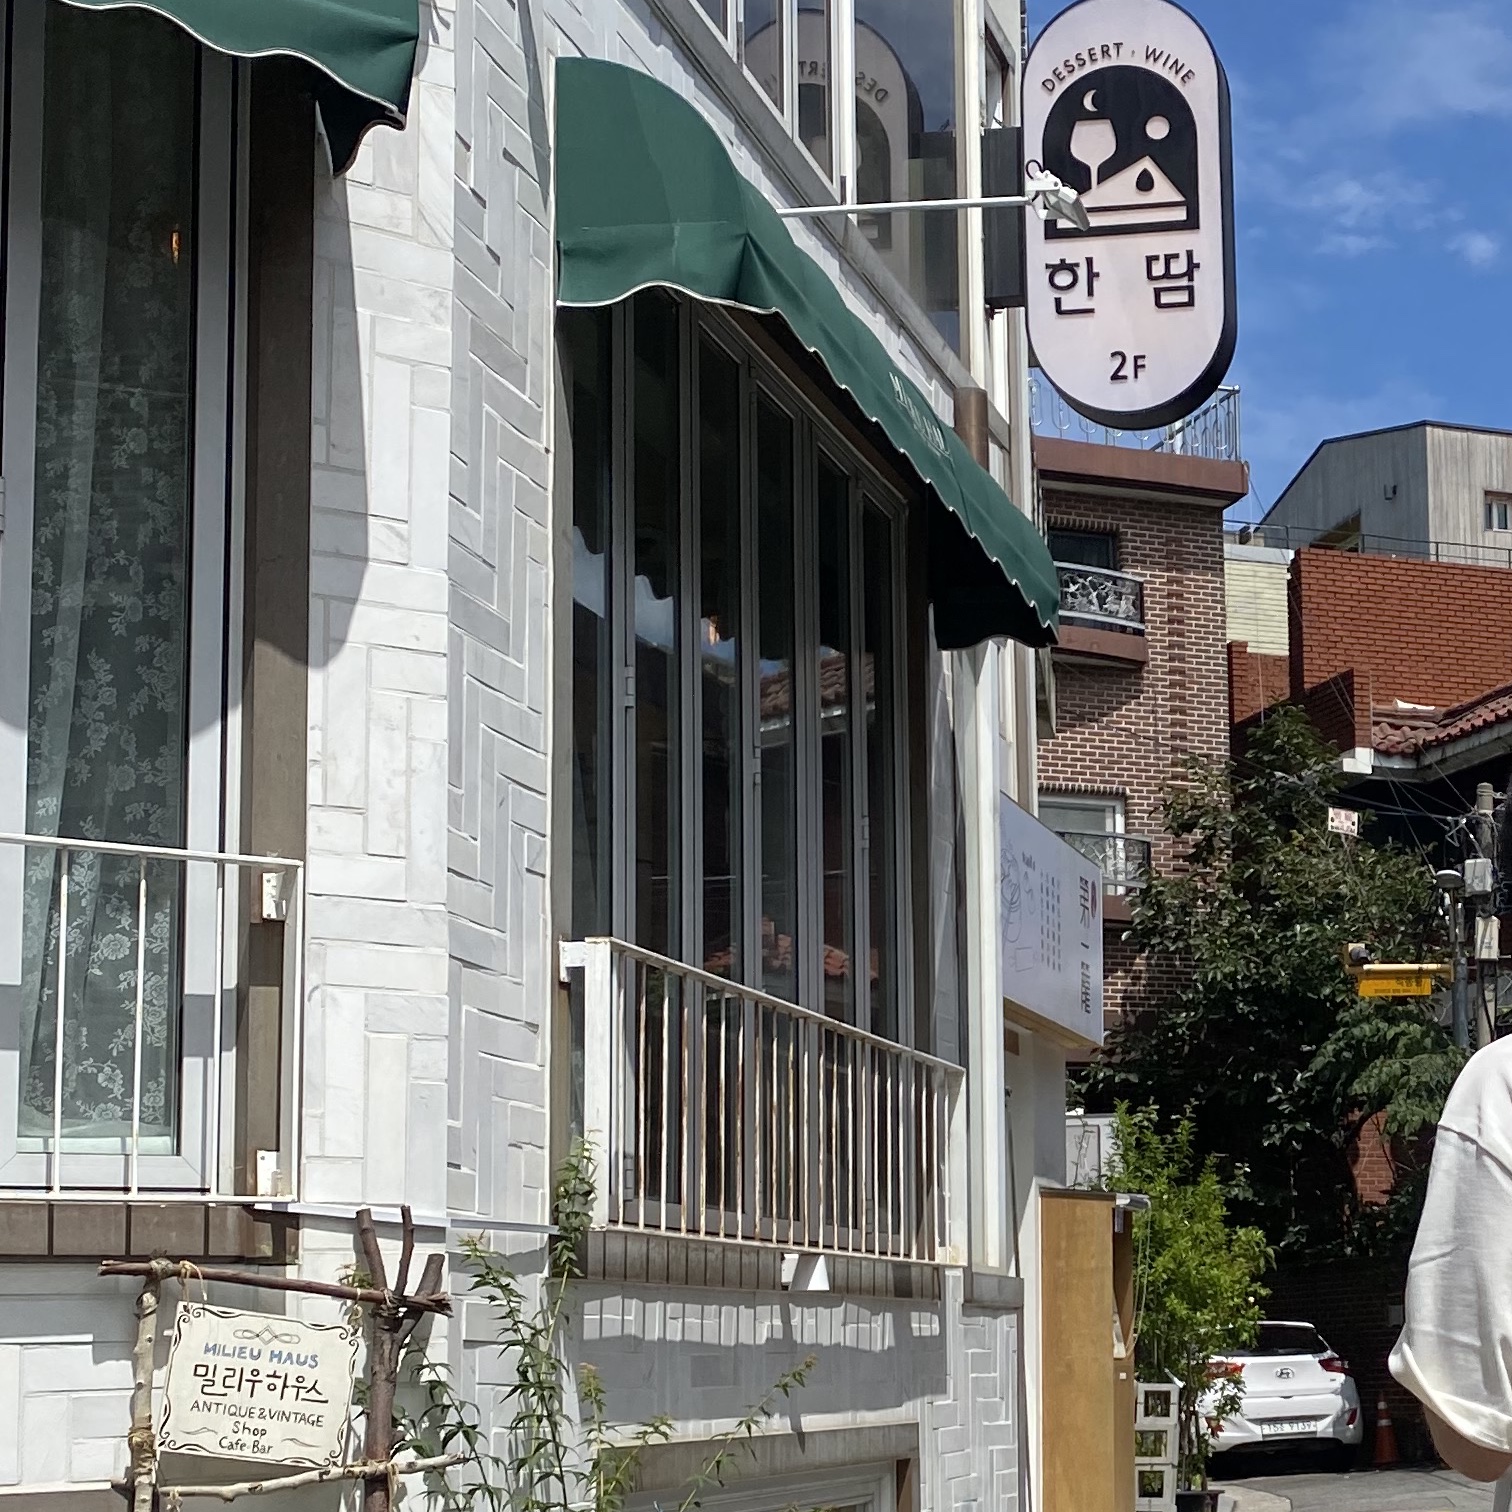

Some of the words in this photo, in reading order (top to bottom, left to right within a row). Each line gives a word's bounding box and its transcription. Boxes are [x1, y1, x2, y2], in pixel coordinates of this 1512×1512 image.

[1042, 42, 1123, 92] DESSERT
[1145, 45, 1195, 84] WINE
[1109, 350, 1147, 381] 2F
[203, 1342, 262, 1361] MILIEU
[268, 1349, 320, 1369] HAUS
[193, 1363, 329, 1404] 밀리우하우스
[231, 1420, 267, 1439] Shop
